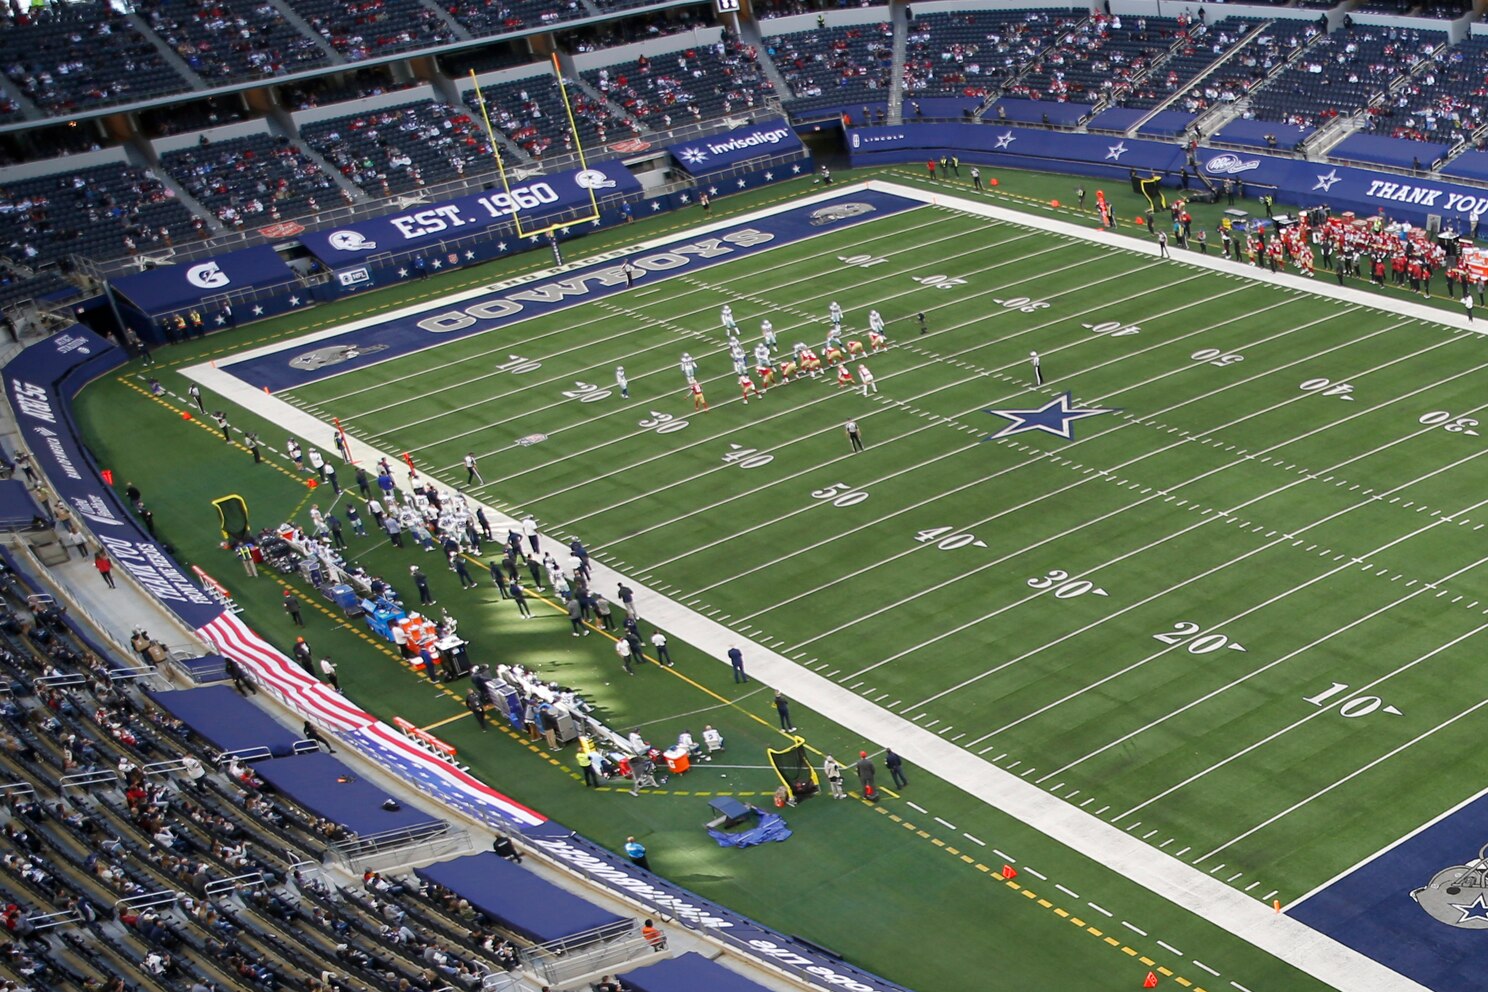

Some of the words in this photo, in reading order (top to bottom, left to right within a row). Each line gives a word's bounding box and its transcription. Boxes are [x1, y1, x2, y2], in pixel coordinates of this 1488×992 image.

[707, 127, 789, 155] invisalign
[865, 134, 904, 143] LINCOLN
[1366, 179, 1442, 213] THANK
[390, 204, 477, 240] EST.
[478, 182, 560, 218] 1960
[417, 229, 775, 333] COWBOYS
[486, 275, 538, 291] END
[549, 245, 643, 275] RACISM
[917, 276, 968, 290] 20
[999, 297, 1051, 313] 30
[1087, 321, 1141, 337] 40
[1191, 348, 1245, 367] 50
[563, 384, 612, 404] 20
[1299, 378, 1349, 398] 40
[639, 414, 690, 434] 30
[1419, 410, 1473, 434] 30
[721, 448, 774, 469] 40
[811, 483, 869, 509] 50
[914, 524, 974, 552] 40
[1027, 569, 1095, 600] 30
[1153, 620, 1230, 657] 20
[1302, 681, 1384, 720] 10
[748, 939, 817, 972] Life
